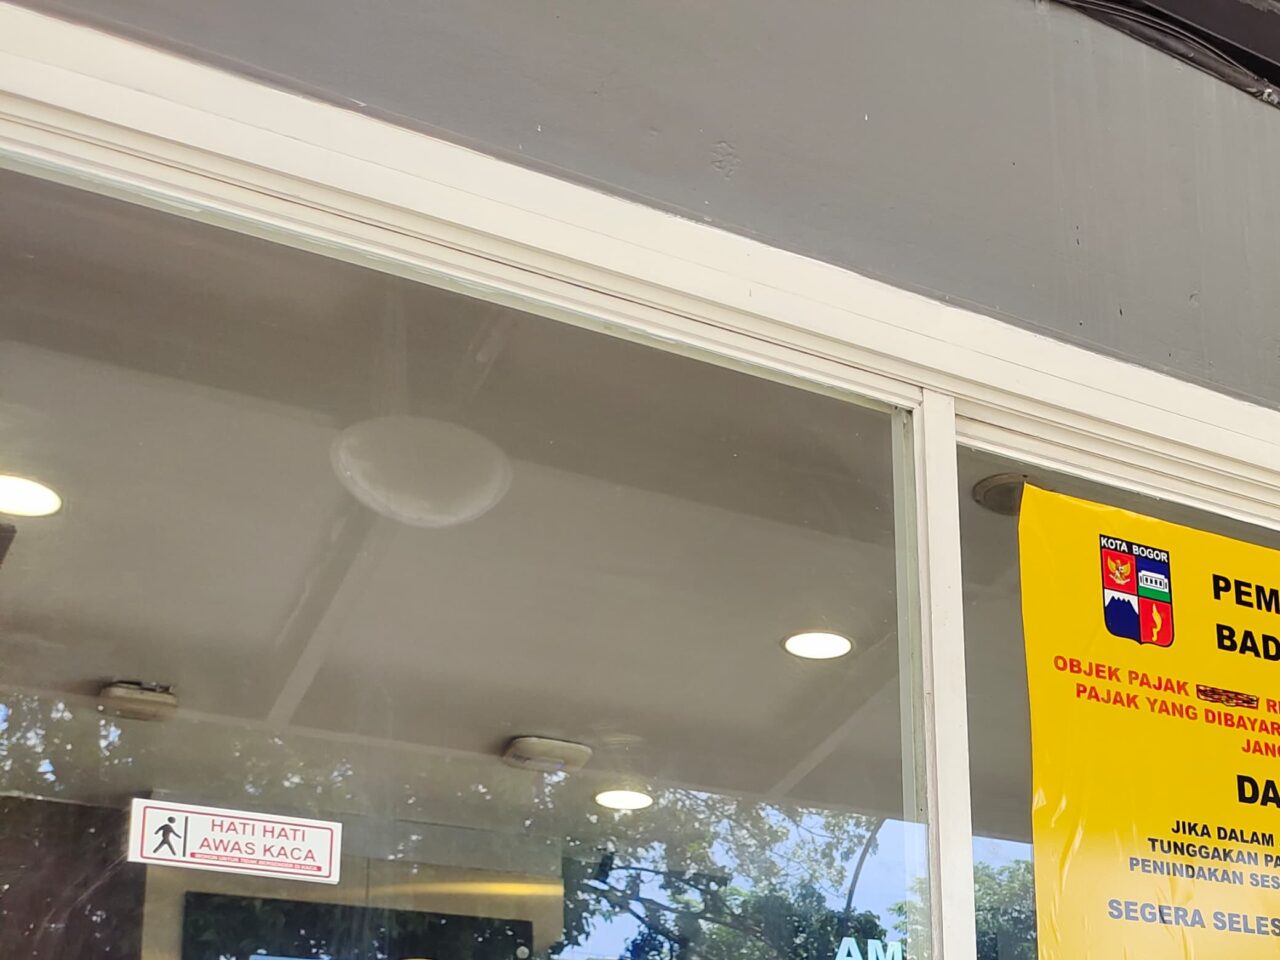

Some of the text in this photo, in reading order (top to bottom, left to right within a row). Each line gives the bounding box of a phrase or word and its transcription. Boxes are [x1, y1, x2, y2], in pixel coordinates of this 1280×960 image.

[1101, 536, 1168, 562] KOTA BOGOR
[1053, 655, 1120, 682] OBJEK
[1128, 670, 1189, 696] PAJAK
[1075, 682, 1139, 709] PAJAK
[1145, 696, 1197, 720] YANG
[211, 819, 306, 842] HATI HATI
[1171, 820, 1211, 838] JIKA
[1216, 826, 1273, 846] DALAM
[199, 837, 256, 855] AWAS
[263, 843, 316, 862] KACA
[1147, 837, 1257, 864] TUNGGAKAN
[1129, 856, 1243, 884] PENINDAKAN
[1107, 898, 1205, 928] SEGERA
